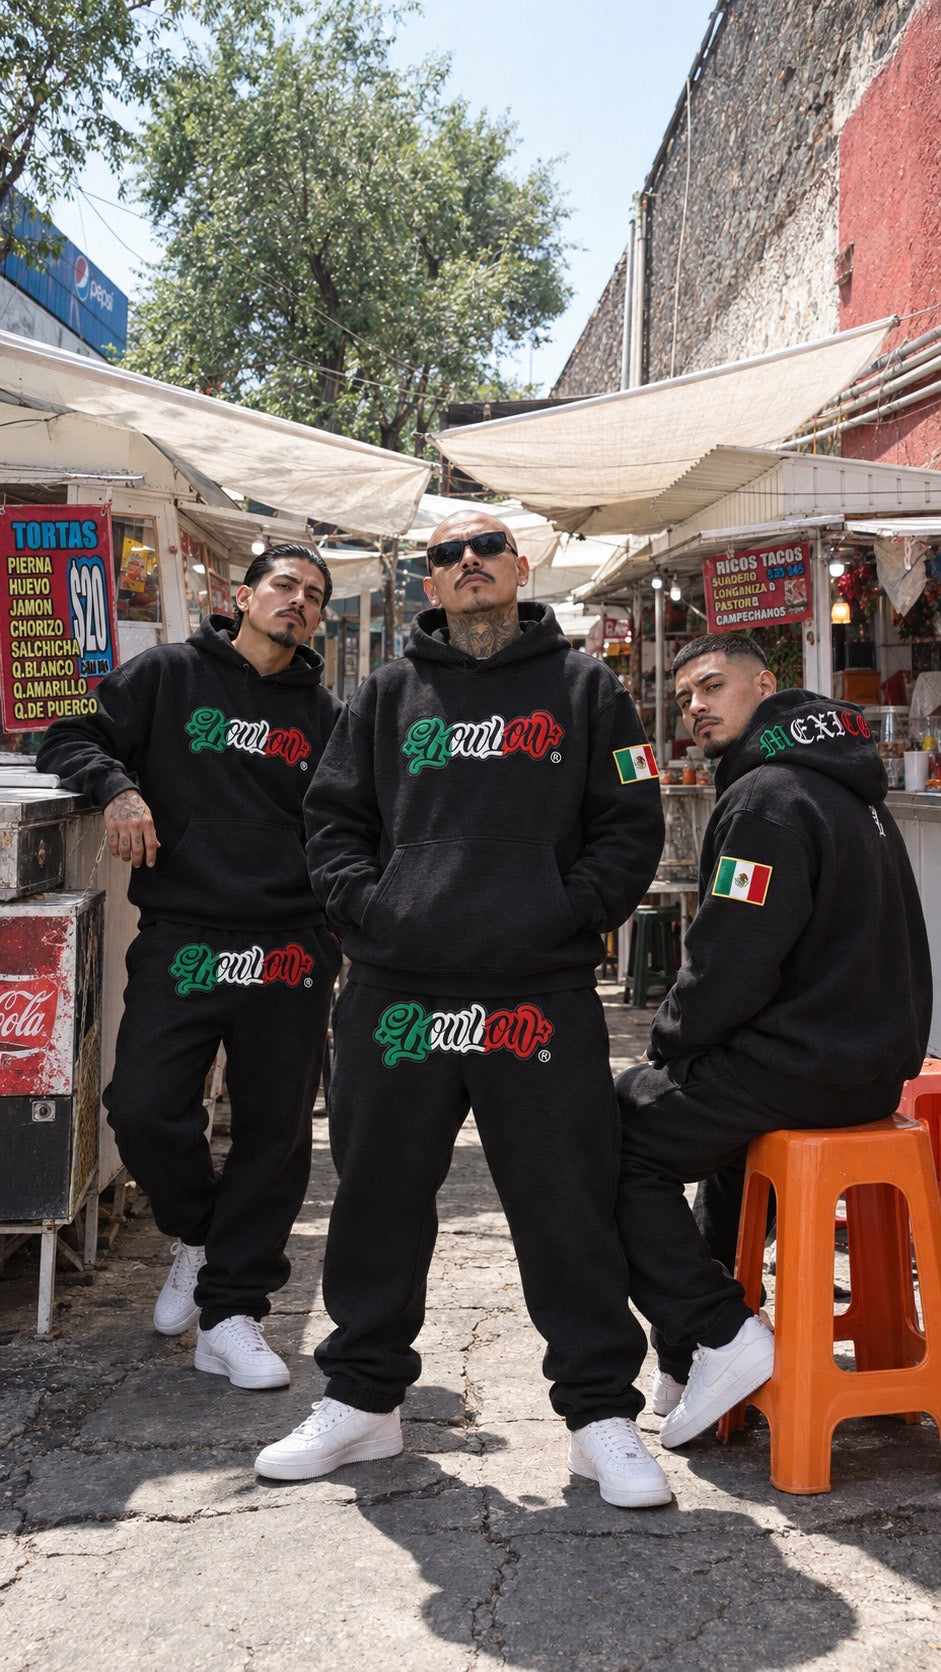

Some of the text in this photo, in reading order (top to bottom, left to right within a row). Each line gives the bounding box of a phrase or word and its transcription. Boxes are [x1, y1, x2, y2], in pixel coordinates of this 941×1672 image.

[12, 520, 98, 550] TORTAS
[8, 557, 53, 574] PIERNA
[716, 555, 757, 575] RICOS
[760, 547, 803, 567] TACOS
[9, 578, 51, 595] HUEVO
[713, 582, 767, 600] LONGANIZA
[10, 599, 53, 617] JAMON
[70, 558, 108, 658] $20
[715, 598, 751, 612] PASTOR
[716, 606, 786, 626] CAMPECHANOS
[10, 619, 64, 638] CHORIZO
[11, 639, 81, 658] SALCHICHA
[12, 659, 74, 678] Q.BLANCO
[13, 678, 87, 699] Q.AMARILLO
[47, 697, 98, 717] PUERCO
[760, 711, 871, 760] MEXICO
